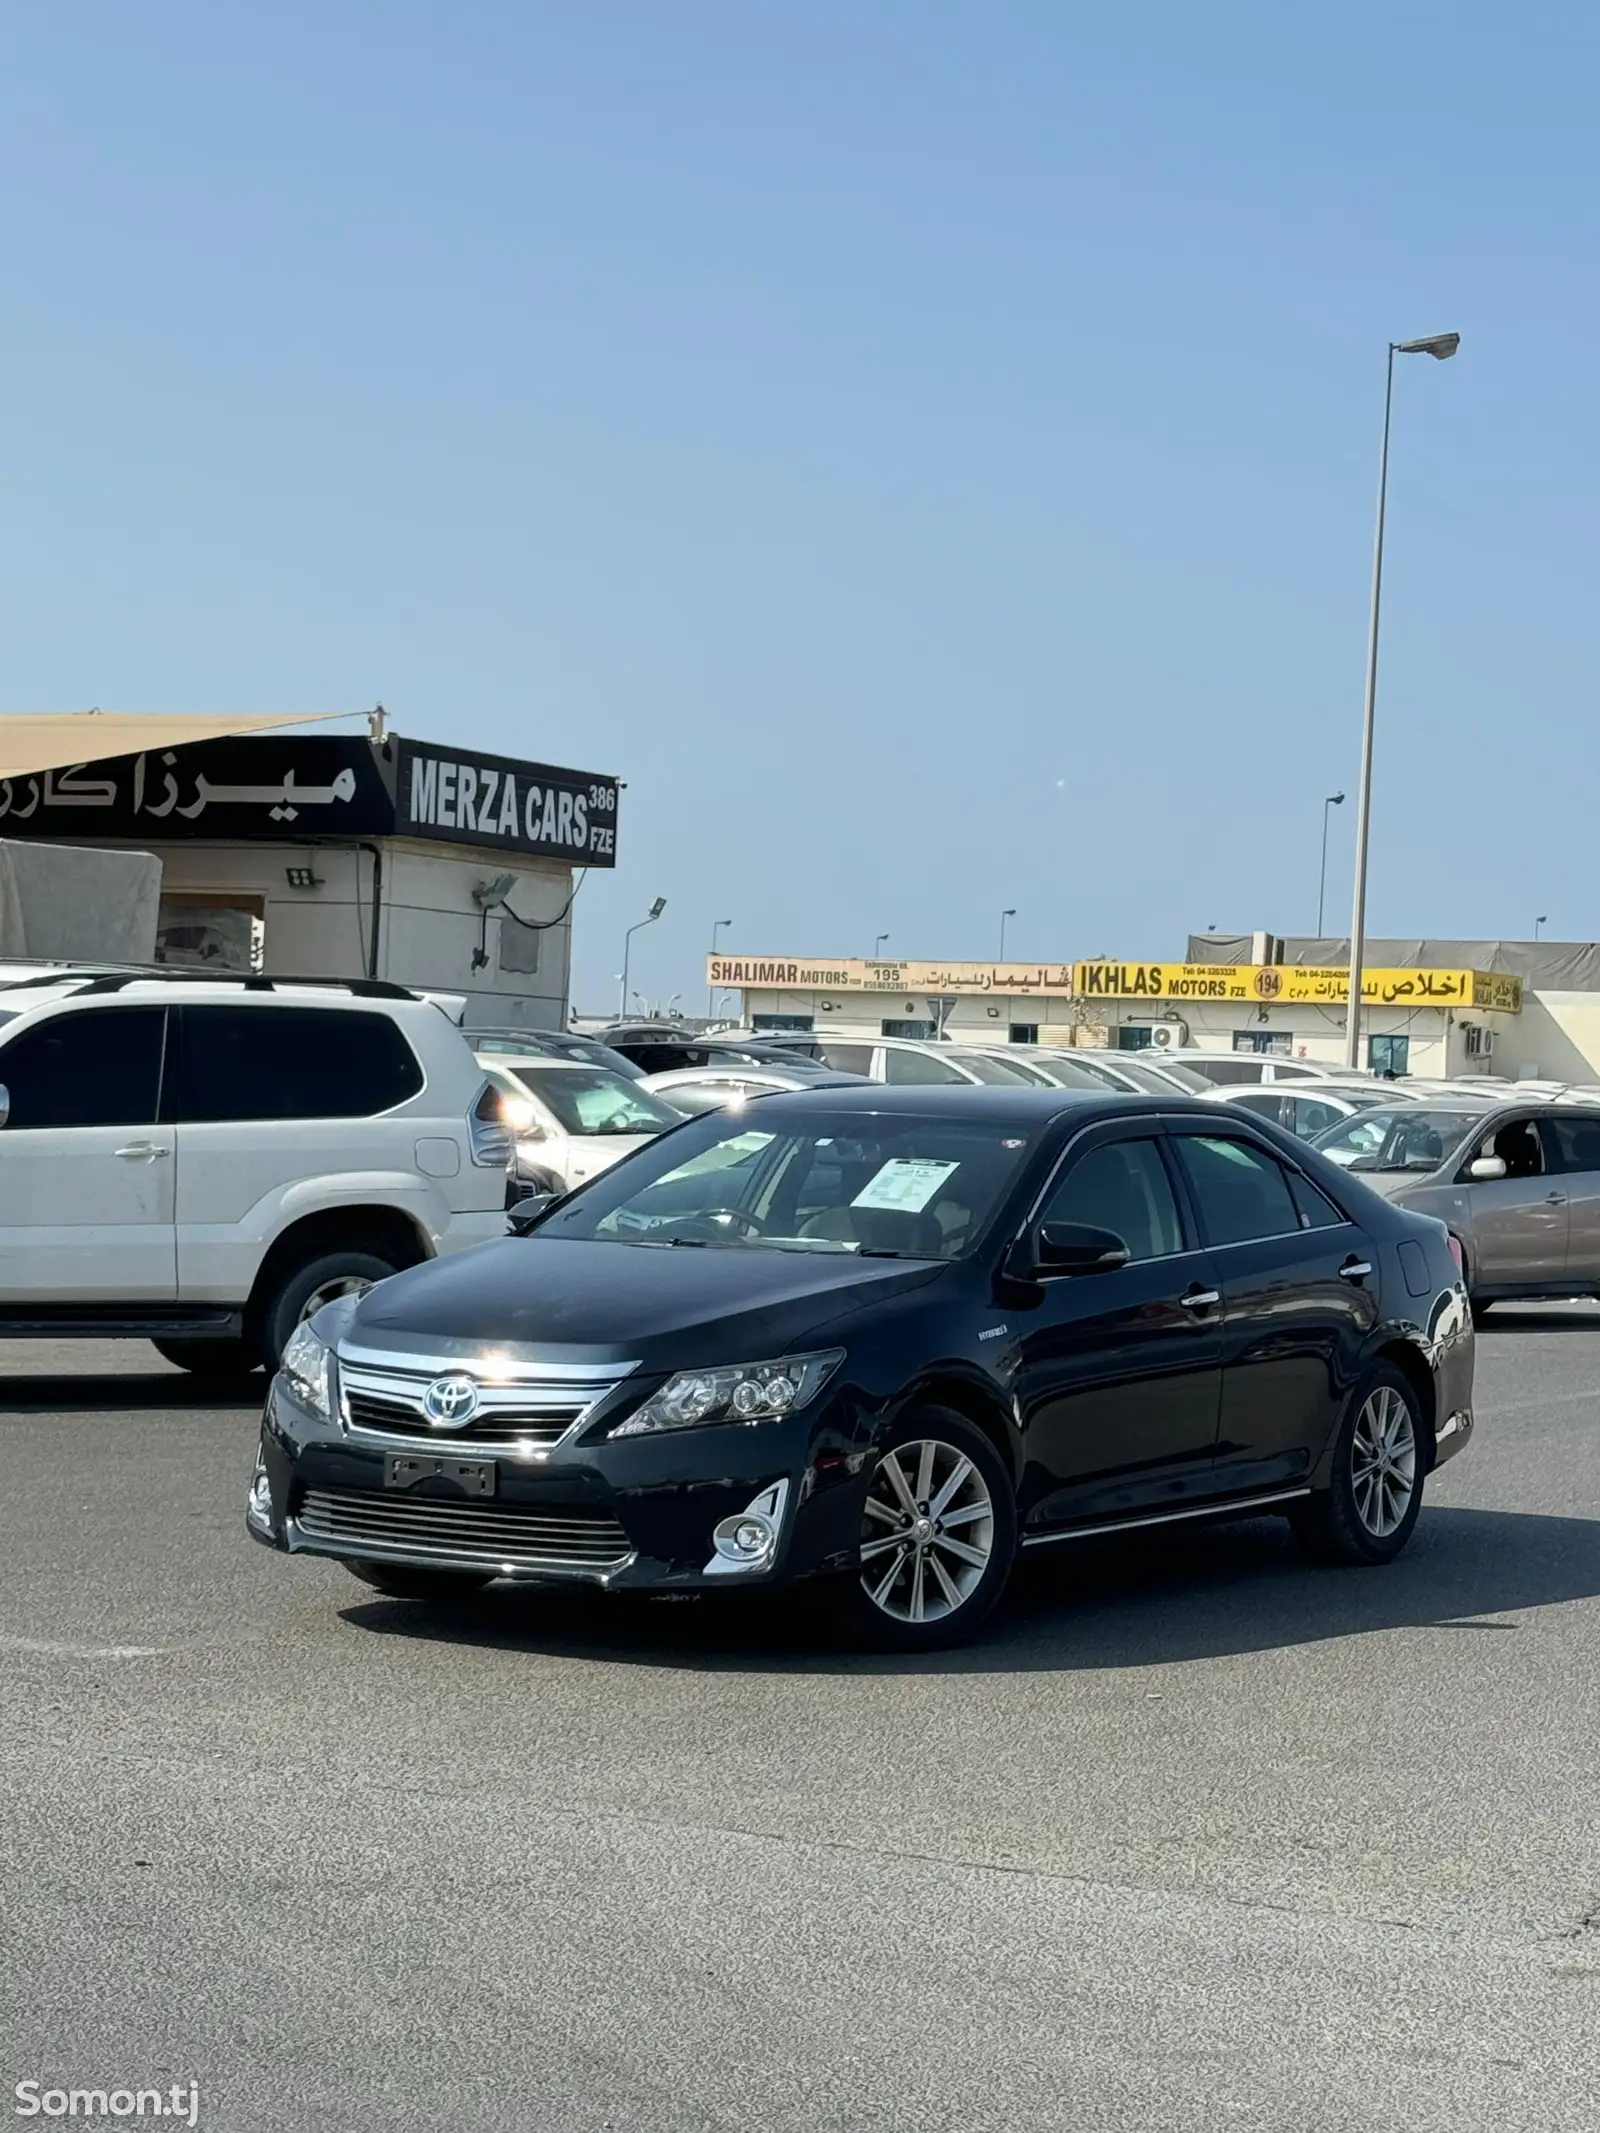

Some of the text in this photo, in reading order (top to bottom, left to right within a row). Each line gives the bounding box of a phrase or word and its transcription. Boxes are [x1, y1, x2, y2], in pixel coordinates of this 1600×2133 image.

[134, 751, 357, 822] ميرزا
[589, 784, 615, 811] 386
[410, 757, 588, 848] MERZA CARS
[590, 826, 614, 854] FZE
[711, 962, 849, 985] SHALIMAR MOTORS
[874, 969, 900, 981] 195
[1081, 965, 1246, 997] IKHLAS MOTORS FZE
[1258, 975, 1279, 993] 194
